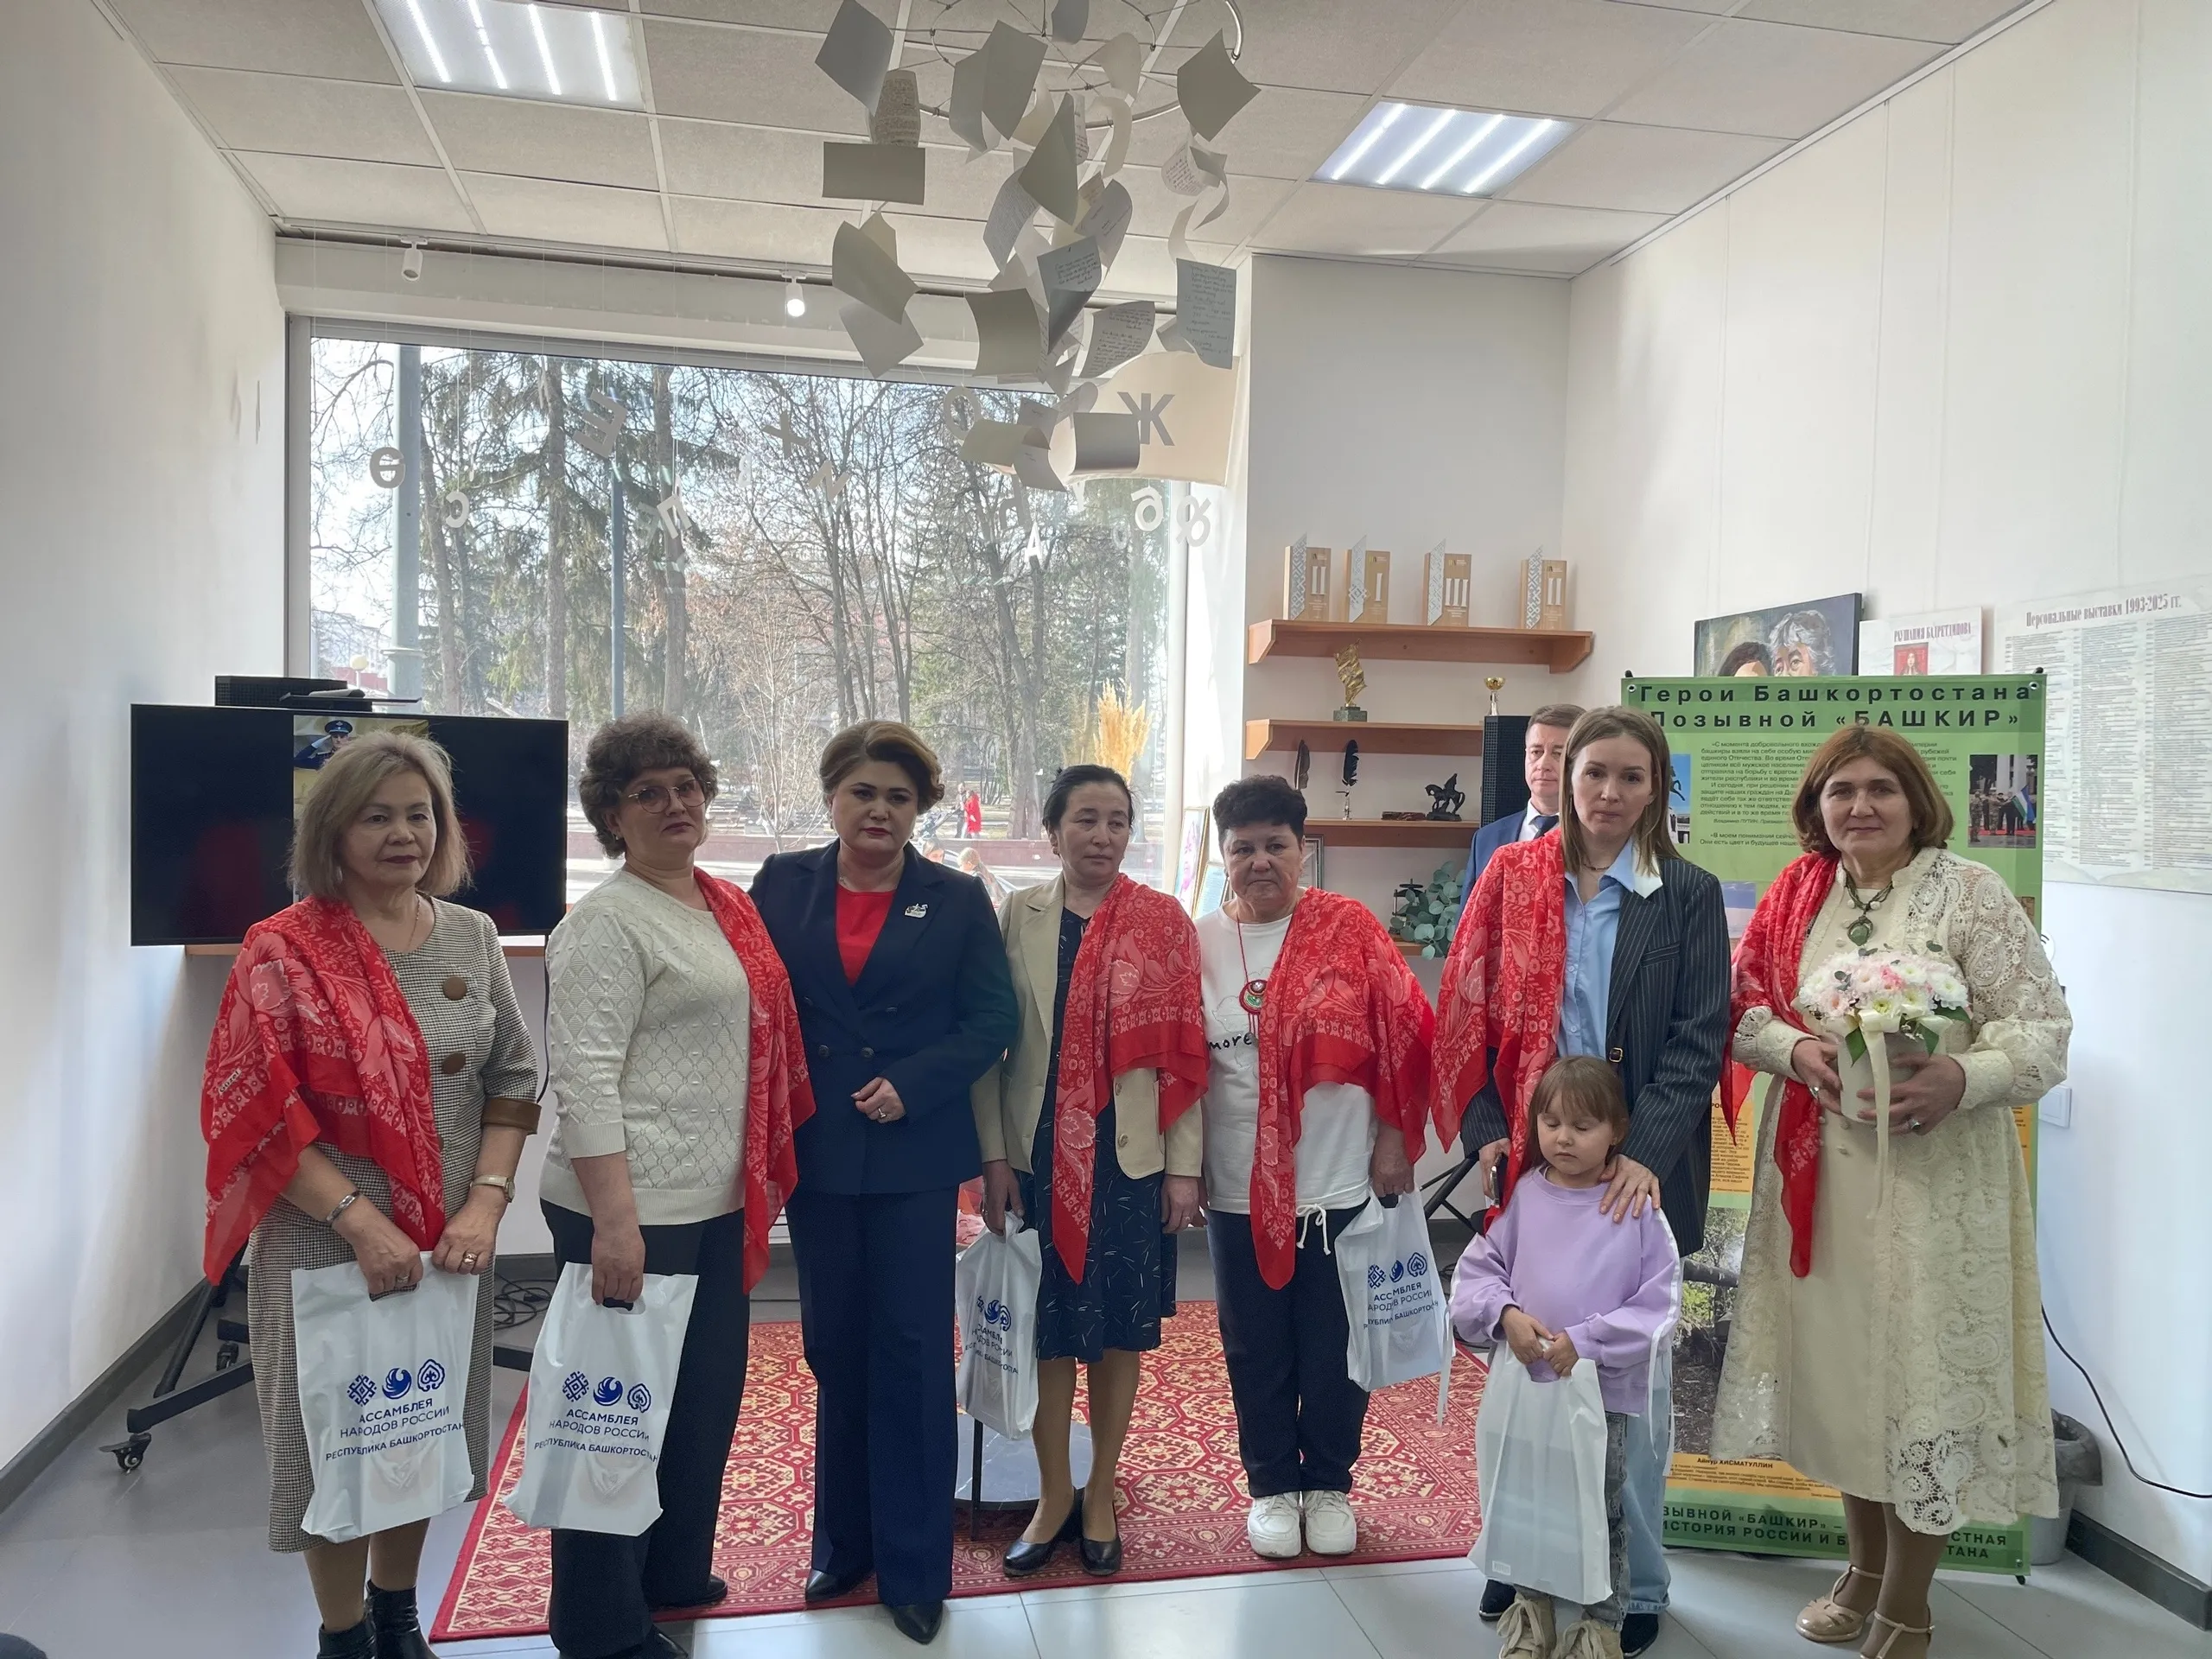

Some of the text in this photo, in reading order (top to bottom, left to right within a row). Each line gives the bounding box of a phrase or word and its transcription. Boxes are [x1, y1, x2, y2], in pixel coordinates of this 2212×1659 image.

[2026, 609, 2082, 629] Персональные
[2084, 604, 2122, 620] выставки
[2126, 594, 2168, 614] 1993-2025
[1641, 685, 2030, 705] Герои Башкортостана
[1651, 709, 2018, 728] Позывной «БАШКИР»
[1374, 1282, 1421, 1301] АССМБЛЕЯ
[359, 1398, 433, 1423] АССАМБЛЕЯ
[567, 1408, 639, 1426] АССАМБЛЕЯ
[340, 1406, 449, 1438] НАРОДОВ РОССИИ
[550, 1420, 650, 1441] НАРОДОВ РОССИИ
[326, 1422, 464, 1461] РЕСПУБЛИКА БАШКОРТОСТАН
[534, 1437, 587, 1452] РЕСПУБЛИКА
[1719, 1459, 1773, 1469] ХИСМАТУЛЛИН
[1738, 1514, 1826, 1529] «БАШКИР»
[1662, 1521, 1736, 1536] ИСТОРИЯ
[1743, 1527, 1812, 1543] РОССИИ
[1819, 1534, 1829, 1544] И
[1951, 1531, 2006, 1545] СТНАЯ
